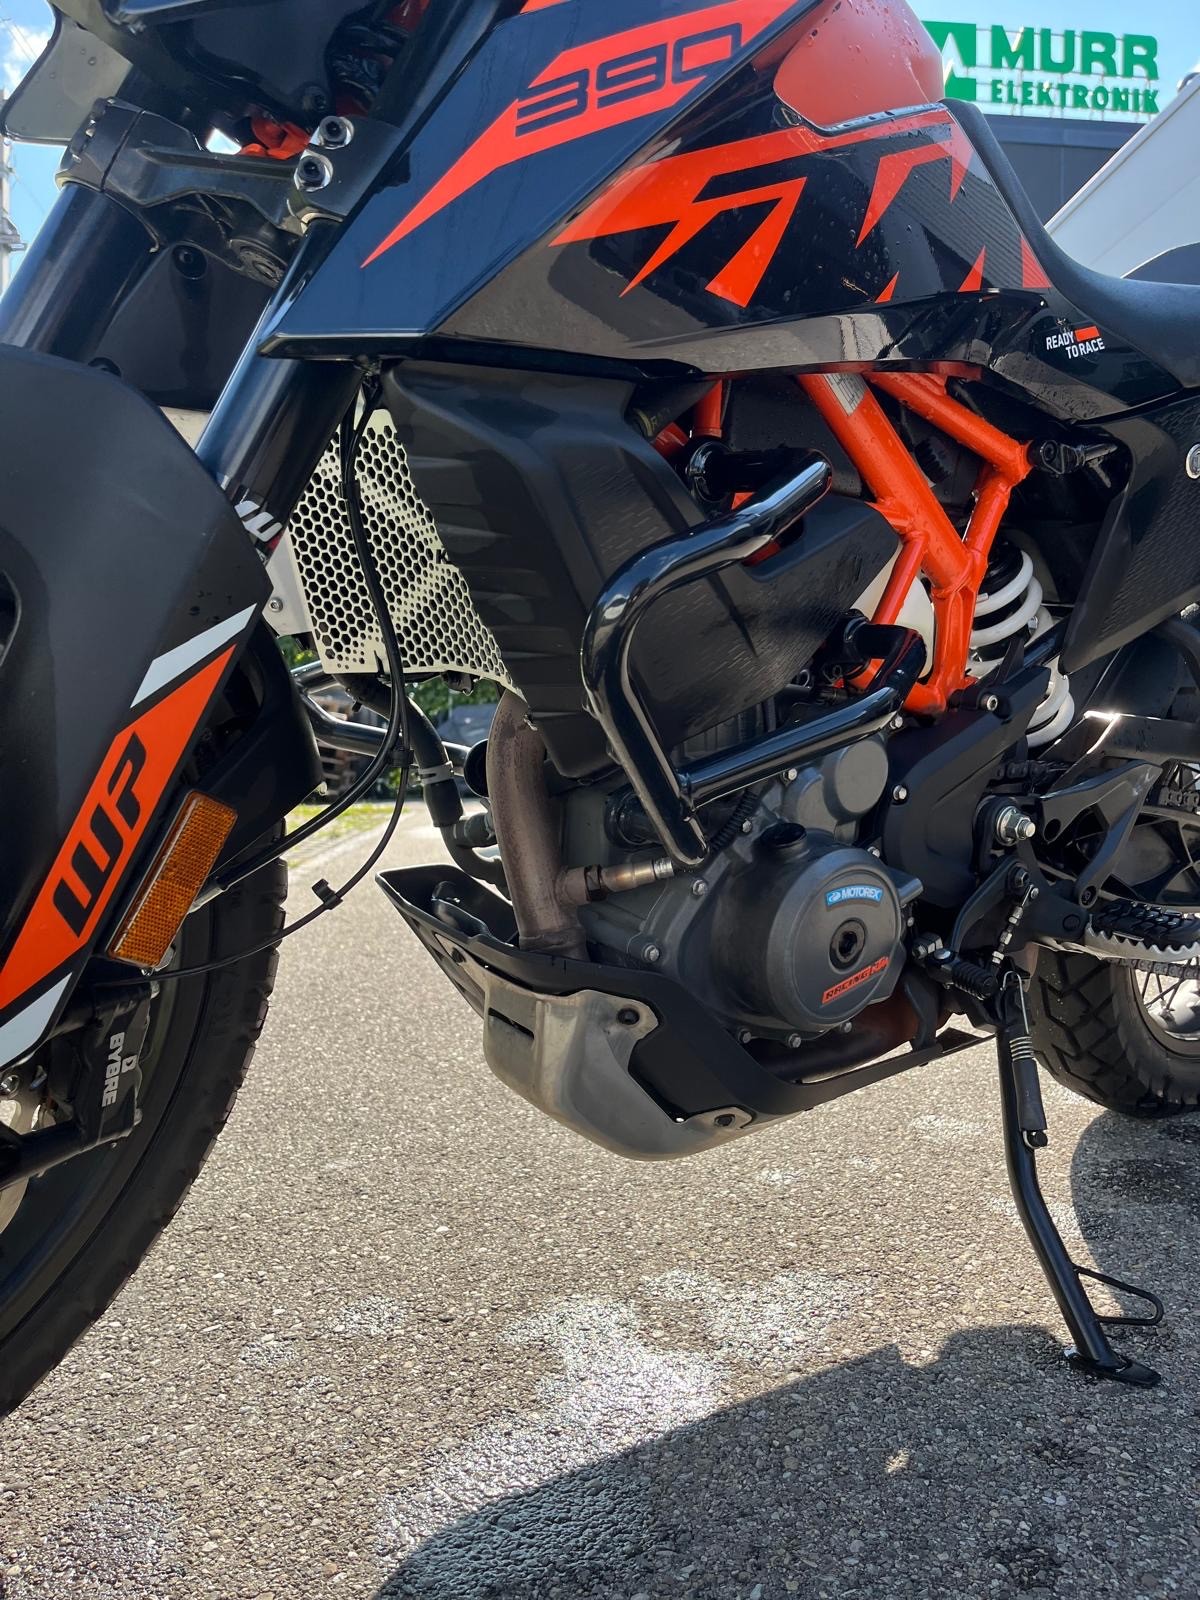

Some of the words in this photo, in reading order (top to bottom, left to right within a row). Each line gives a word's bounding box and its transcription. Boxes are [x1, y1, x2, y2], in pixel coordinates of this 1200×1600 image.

[990, 25, 1159, 80] MURR
[515, 22, 742, 138] 390
[991, 79, 1160, 114] ELEKTRONIK
[1045, 331, 1074, 351] READY
[1065, 344, 1079, 359] TO
[1078, 338, 1105, 356] RACE
[840, 886, 882, 901] MOTOREX
[102, 1032, 125, 1107] BYBRE
